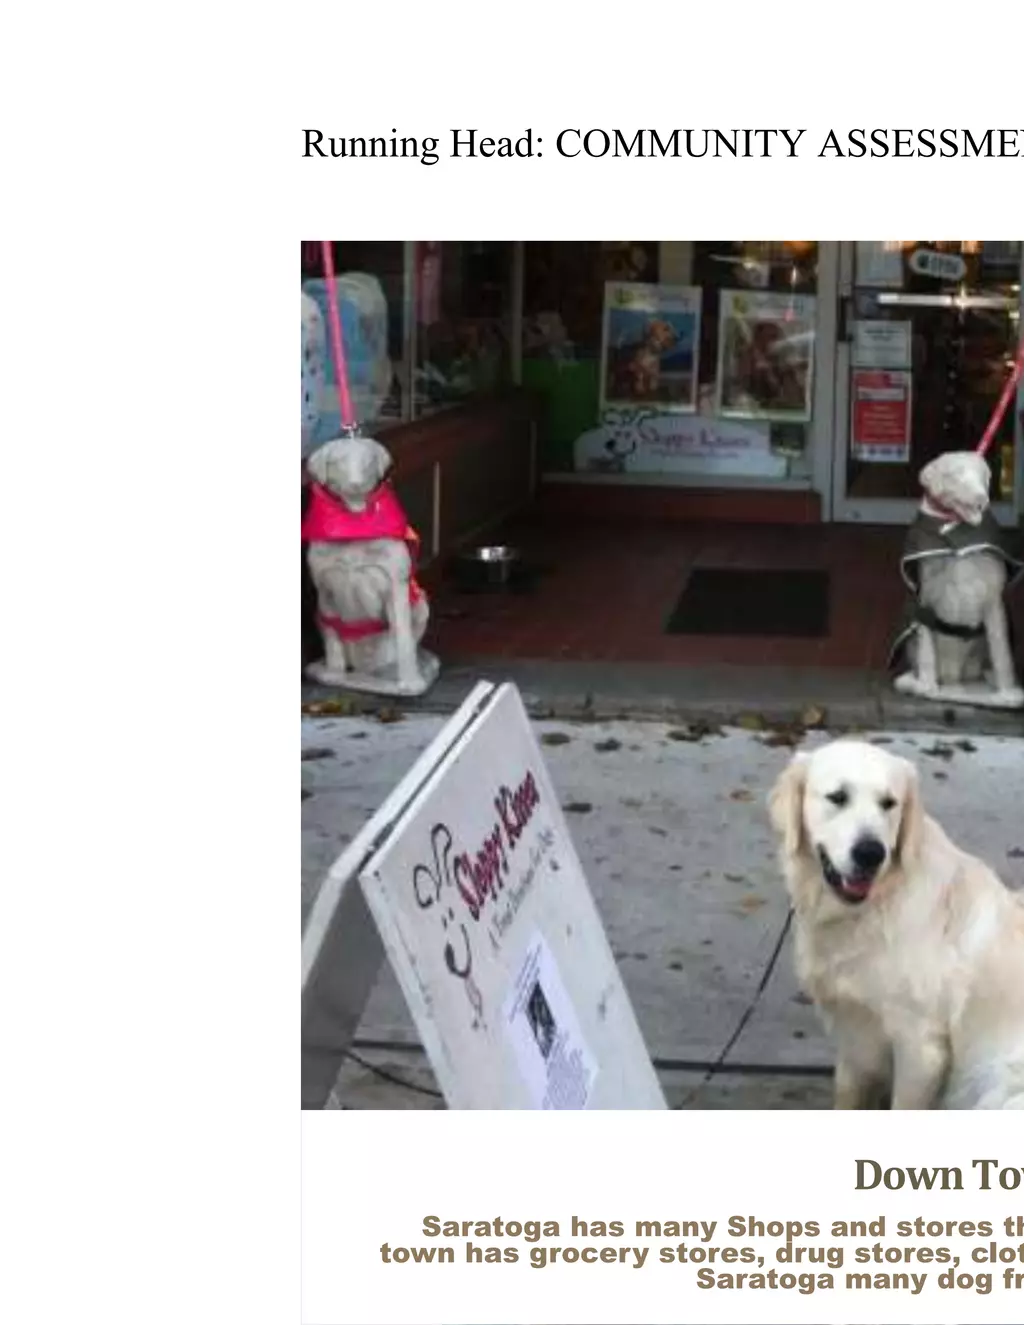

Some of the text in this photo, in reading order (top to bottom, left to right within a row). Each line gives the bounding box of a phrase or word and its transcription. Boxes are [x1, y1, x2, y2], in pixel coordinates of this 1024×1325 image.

[302, 128, 439, 165] Running
[450, 128, 542, 157] Head:
[557, 129, 806, 157] COMMUNITY
